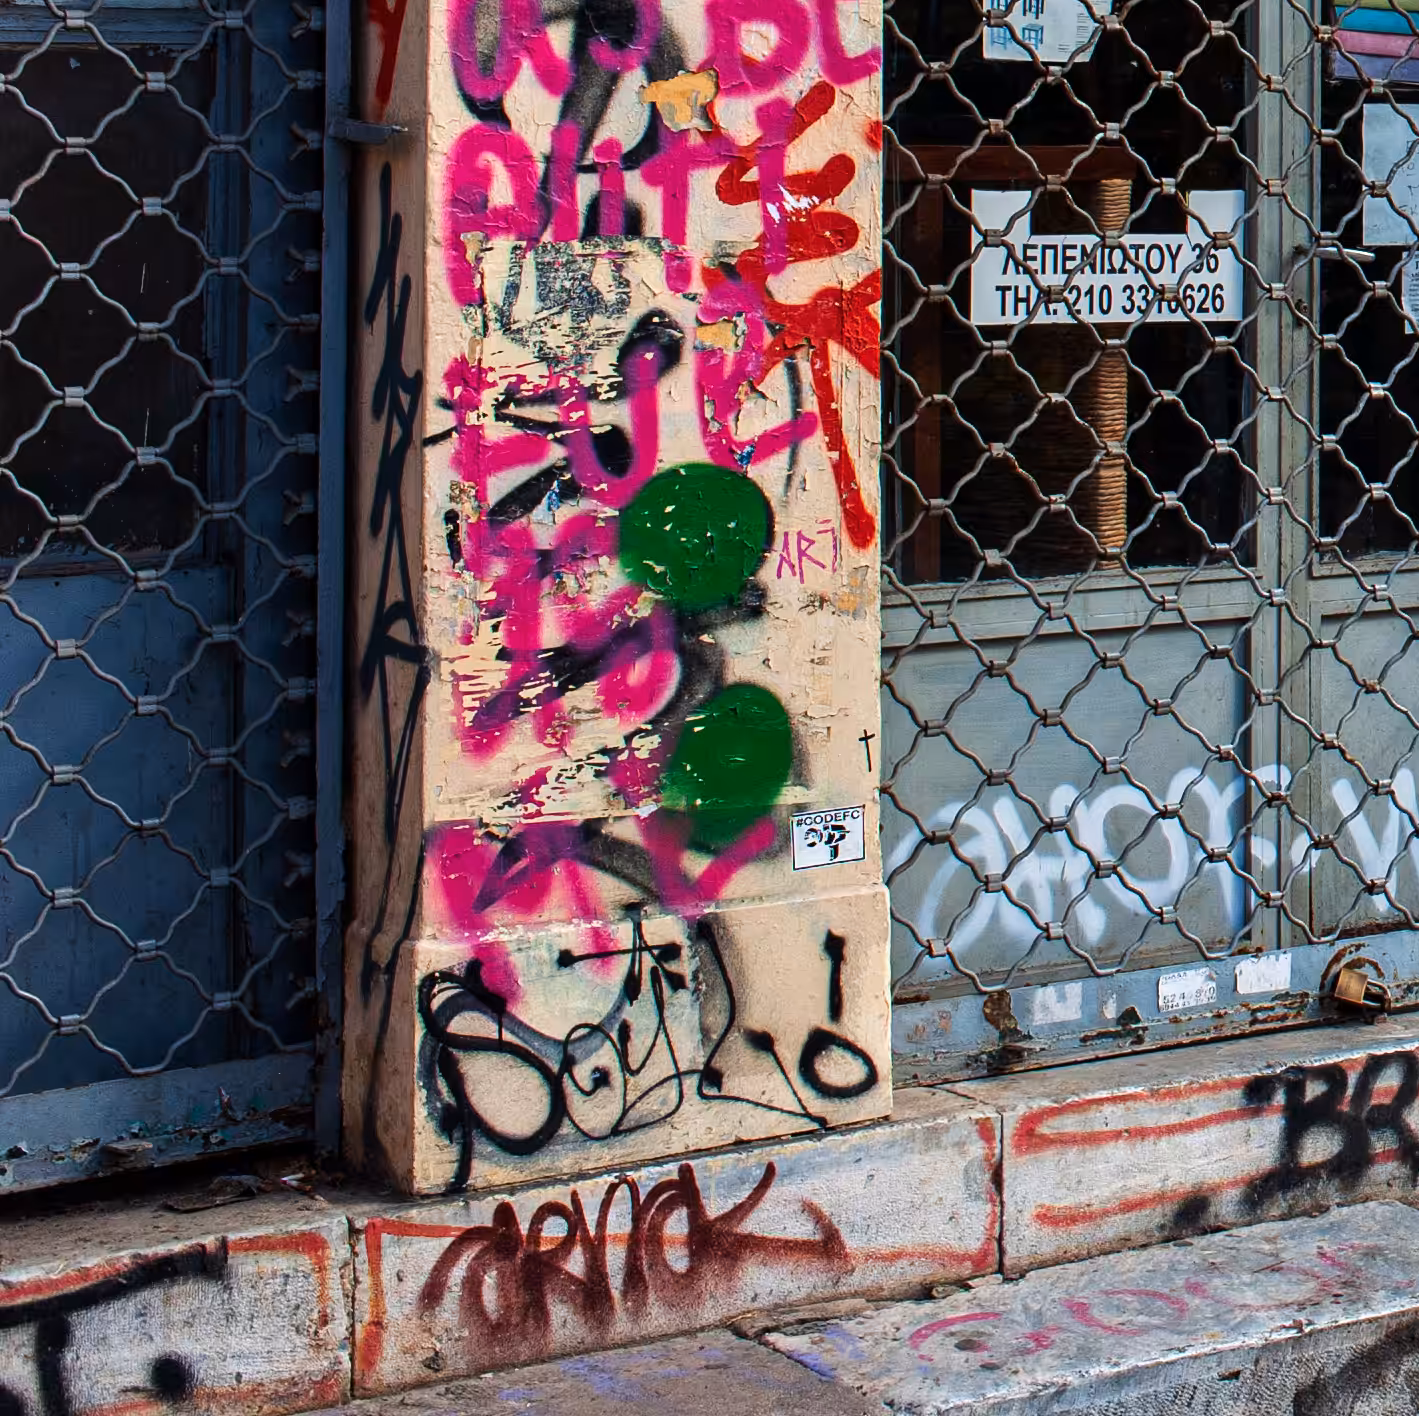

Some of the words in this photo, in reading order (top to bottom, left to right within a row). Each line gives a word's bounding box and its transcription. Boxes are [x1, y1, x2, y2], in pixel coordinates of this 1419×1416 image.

[1002, 244, 1182, 275] ΛΕΠΕΝΙΩΤΟΥ
[1191, 243, 1220, 274] 36
[1068, 284, 1112, 315] 210
[796, 810, 860, 827] #CODEFC
